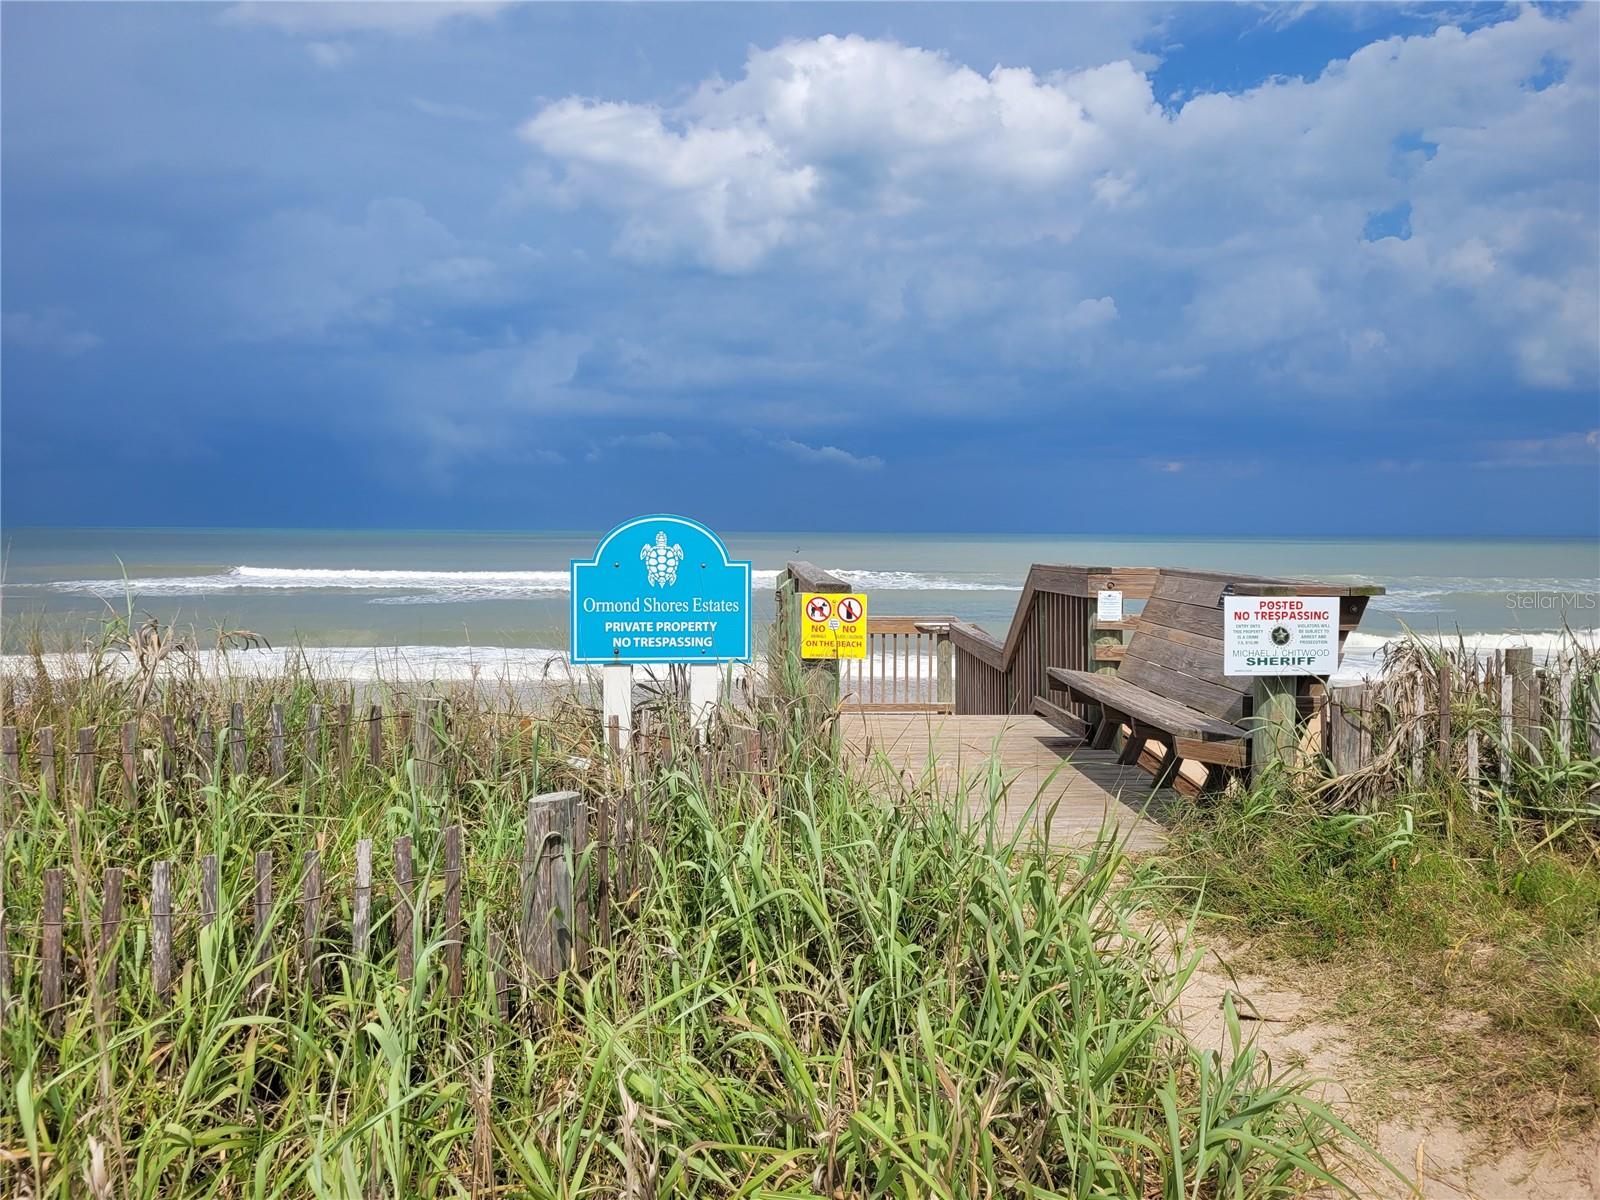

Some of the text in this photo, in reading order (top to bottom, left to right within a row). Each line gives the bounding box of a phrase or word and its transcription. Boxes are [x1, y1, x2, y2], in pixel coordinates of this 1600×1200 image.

[583, 597, 739, 613] Ormond Shores Estates
[1259, 601, 1304, 610] POSTED
[1234, 611, 1329, 620] NO TRESPASSING
[605, 621, 717, 632] PRIVATE PROPERTY
[811, 625, 826, 633] NO
[842, 625, 857, 633] NO
[612, 637, 713, 648] NO TRESPASSING
[1233, 649, 1271, 658] MICHAEL
[1281, 648, 1330, 657] CHITWOOD
[1246, 657, 1316, 666] SHERIFF
